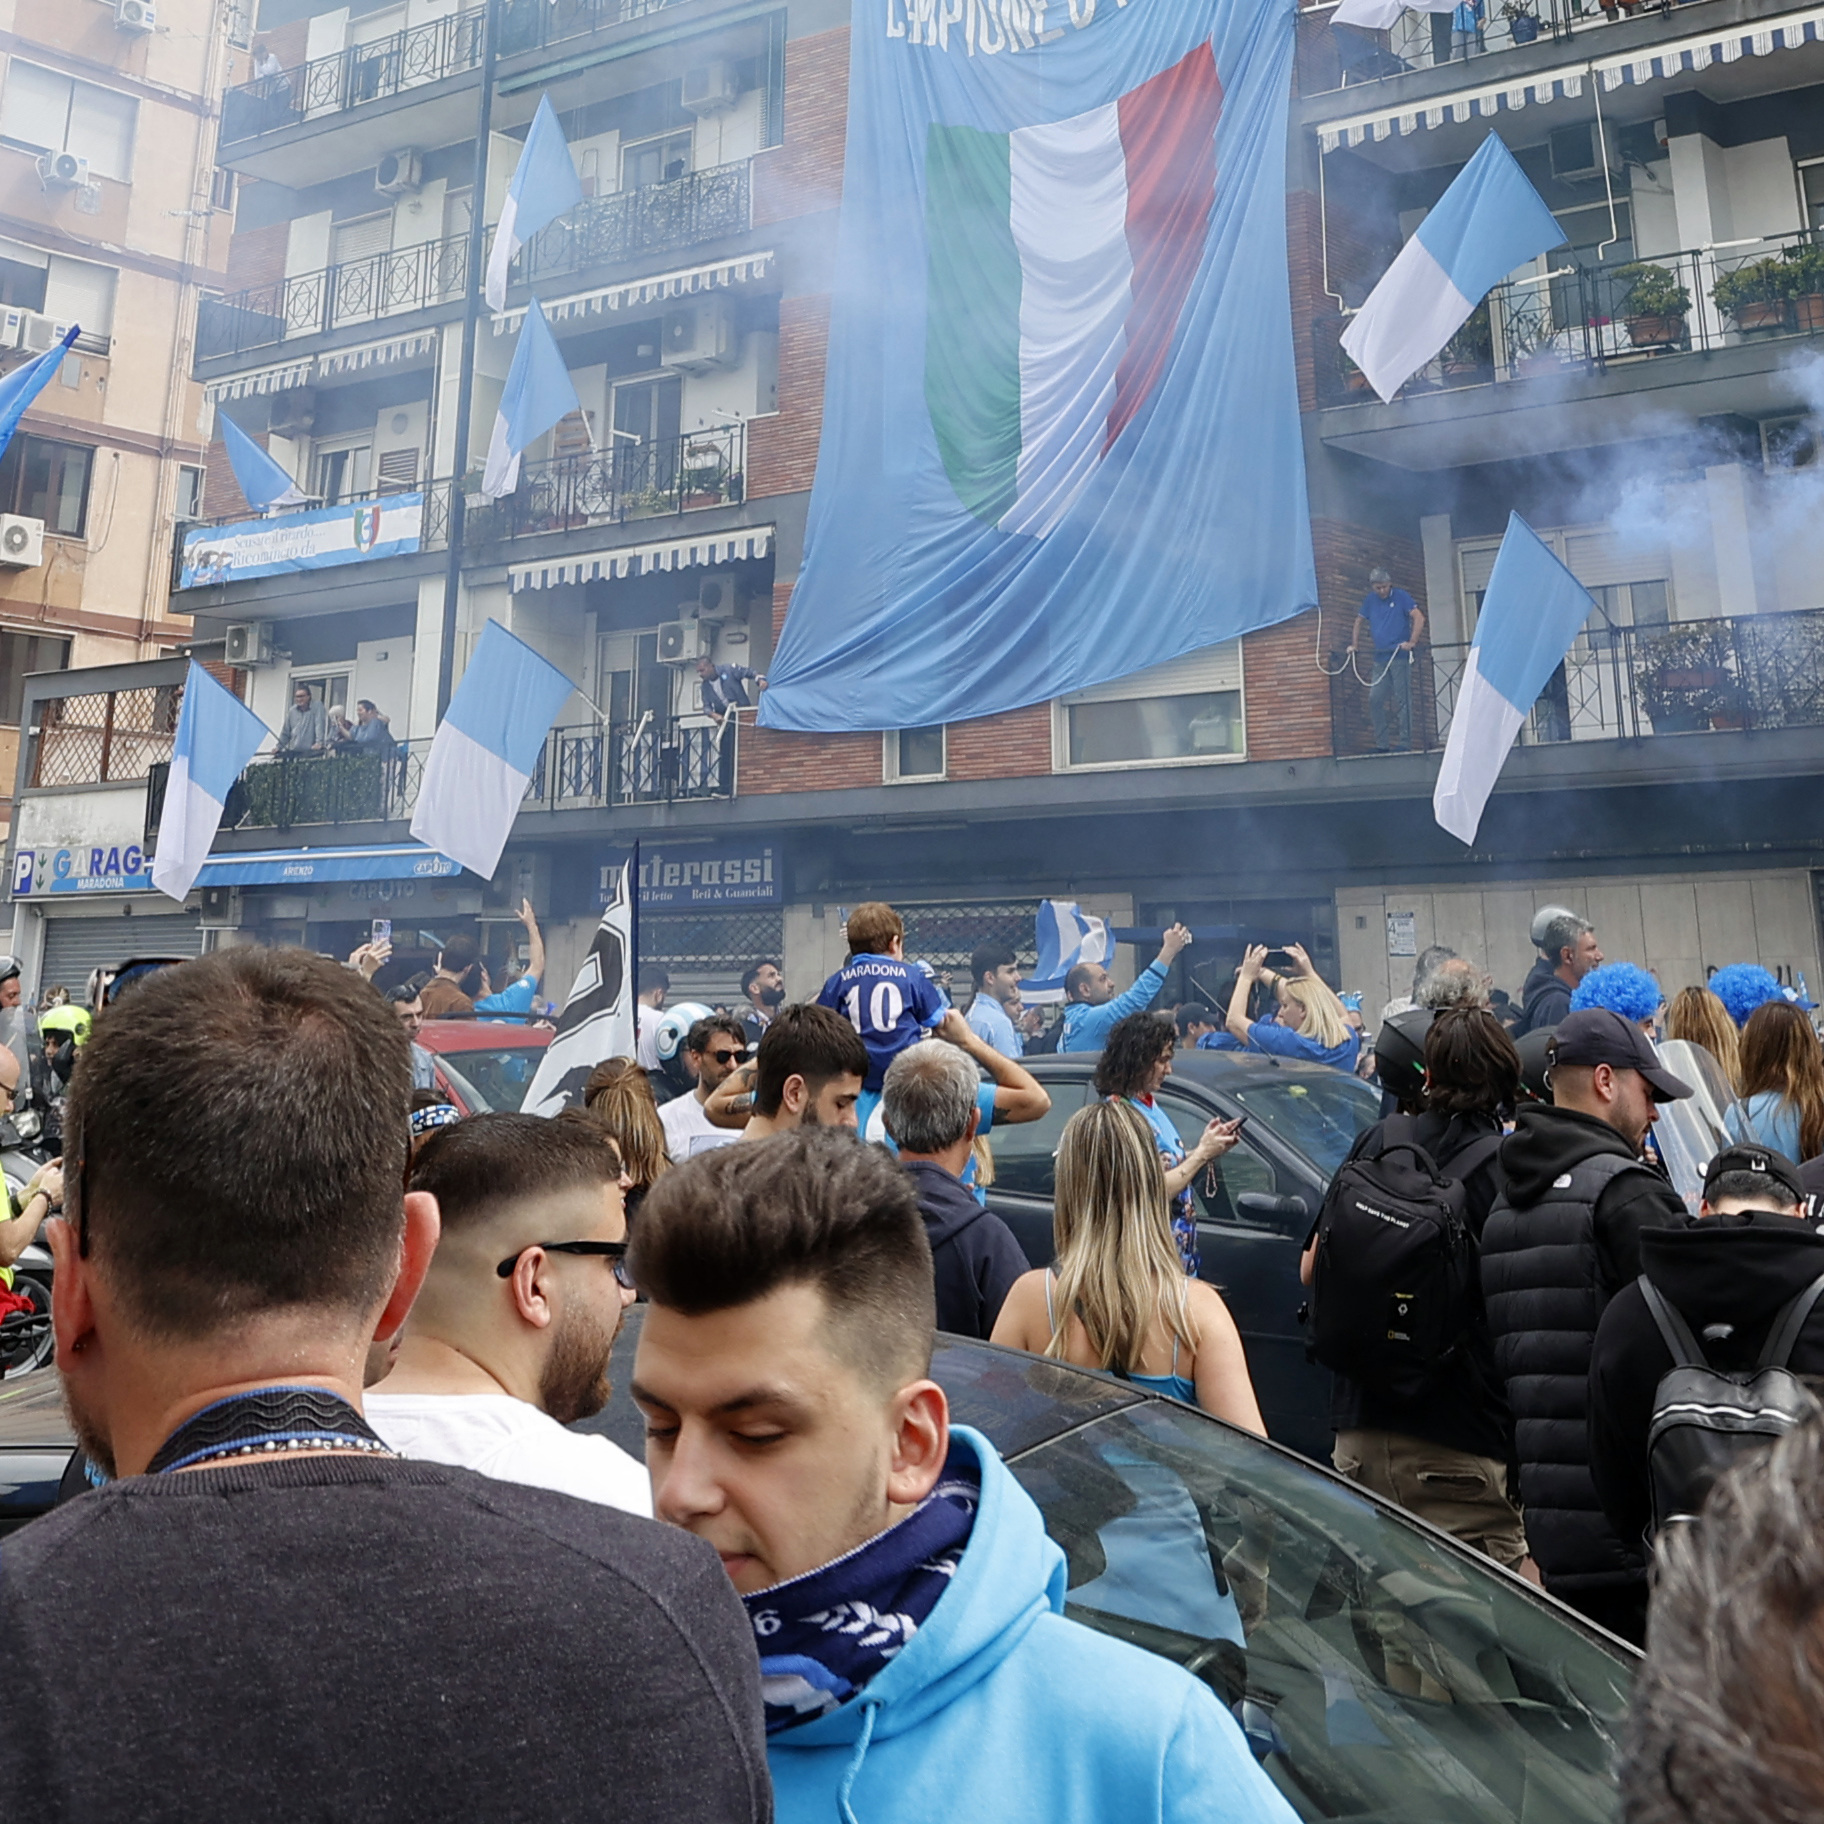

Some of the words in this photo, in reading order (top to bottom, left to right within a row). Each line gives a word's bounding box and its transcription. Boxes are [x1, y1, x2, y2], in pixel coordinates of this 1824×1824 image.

[359, 513, 375, 544] 3
[233, 541, 298, 567] Ricomincio
[52, 845, 153, 879] GARAG
[413, 856, 453, 876] CAPUTO
[77, 876, 125, 890] MARADONA
[348, 880, 417, 902] CAPUTO
[725, 885, 774, 899] Guanciali
[840, 964, 907, 982] MARADONA
[844, 981, 904, 1035] 10
